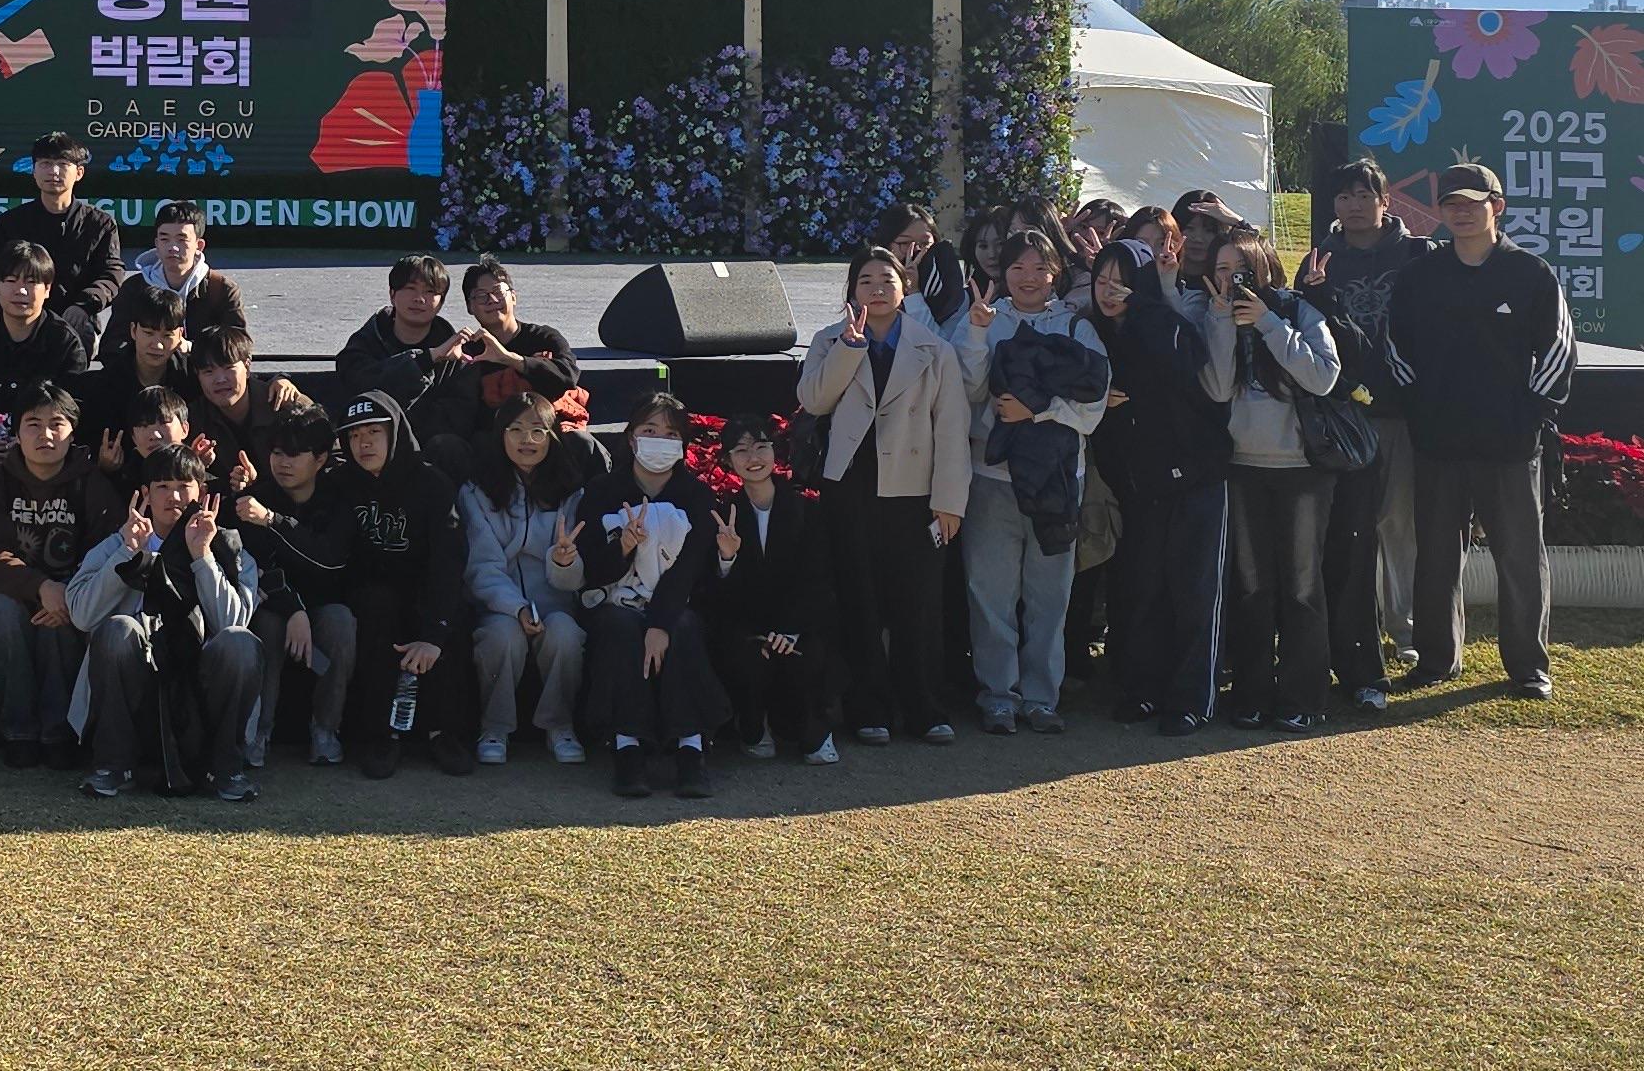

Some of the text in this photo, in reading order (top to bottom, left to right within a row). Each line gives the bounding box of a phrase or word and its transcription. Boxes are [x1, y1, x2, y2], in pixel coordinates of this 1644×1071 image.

[91, 35, 251, 87] 박람회
[87, 121, 254, 139] GARDEN SHOW
[1502, 109, 1607, 144] 2025
[1505, 150, 1607, 201] 대구
[155, 198, 300, 227] RDEN
[312, 199, 415, 228] SHOW
[1505, 206, 1604, 257] 정원
[348, 401, 374, 417] EEE
